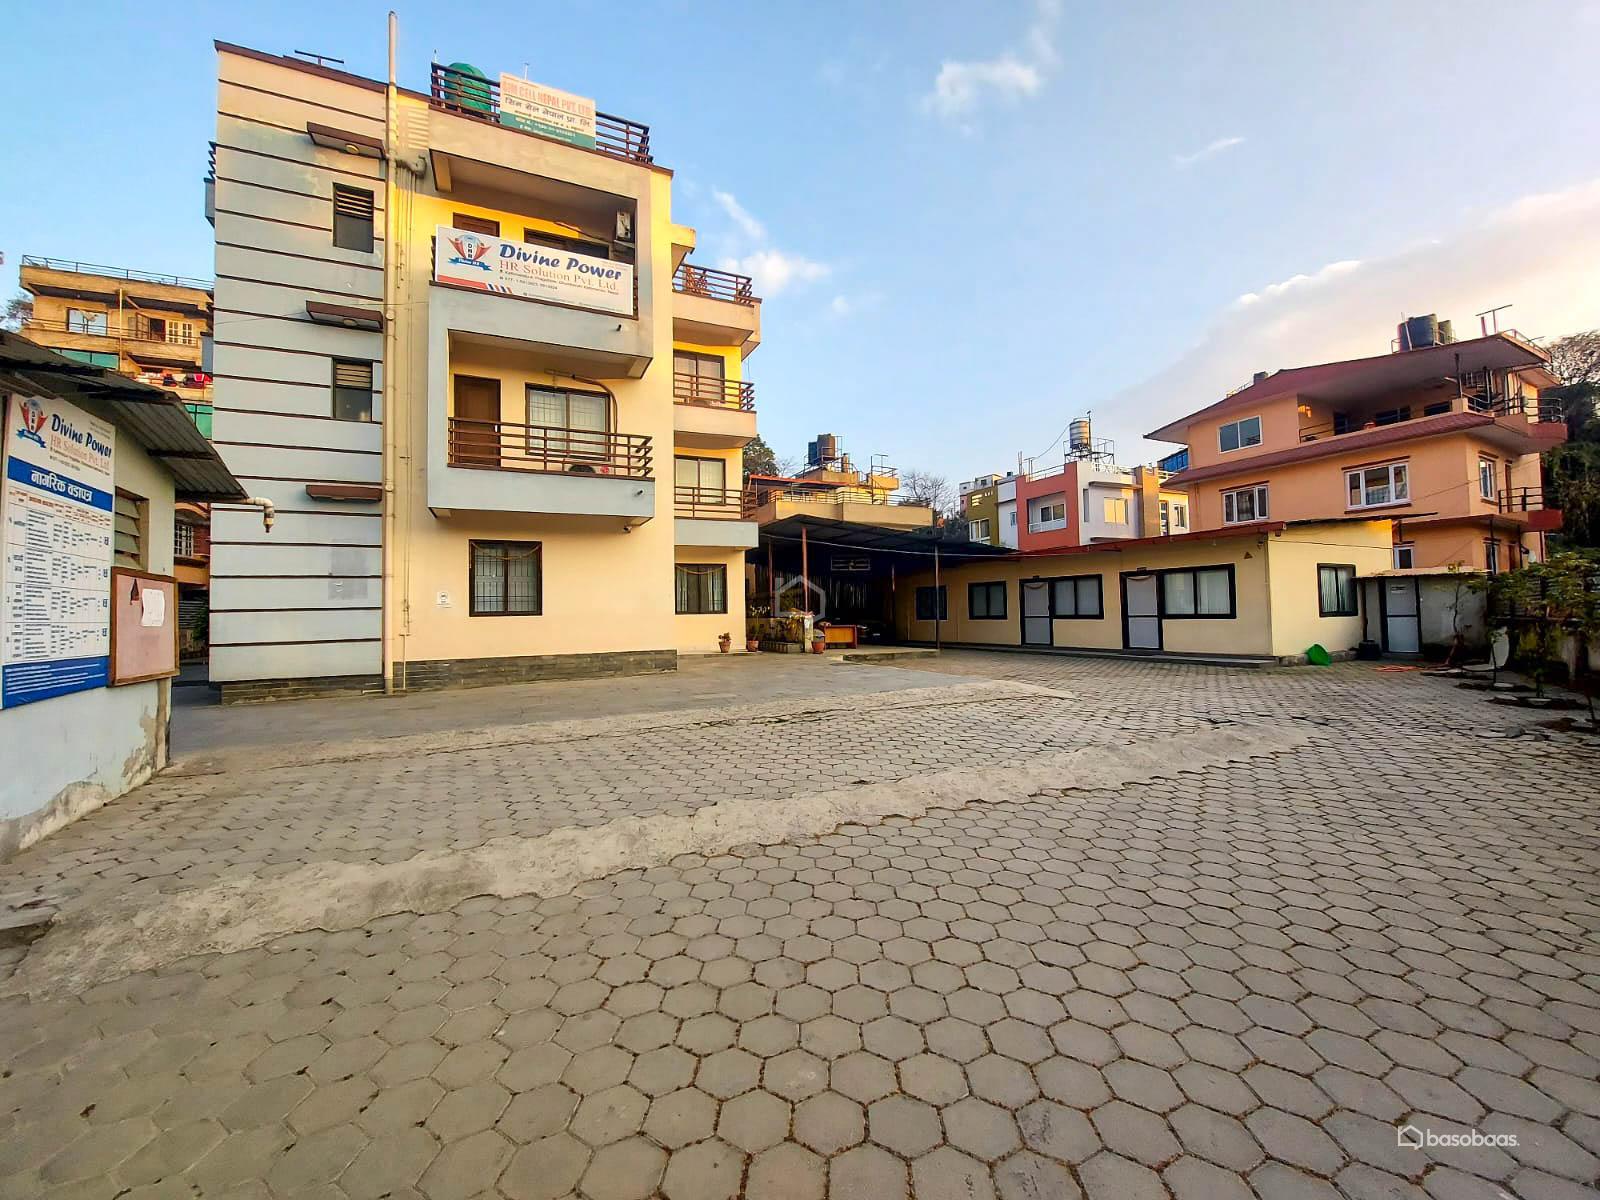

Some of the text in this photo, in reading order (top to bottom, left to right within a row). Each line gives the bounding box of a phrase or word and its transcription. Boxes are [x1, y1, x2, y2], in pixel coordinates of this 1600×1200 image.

[537, 91, 560, 108] NEPAL
[500, 244, 561, 268] Divine
[566, 257, 622, 280] Power
[500, 260, 519, 272] HR
[523, 264, 570, 281] Solution
[51, 413, 83, 444] Divine
[85, 432, 112, 458] Power
[31, 470, 66, 492] नागरिक
